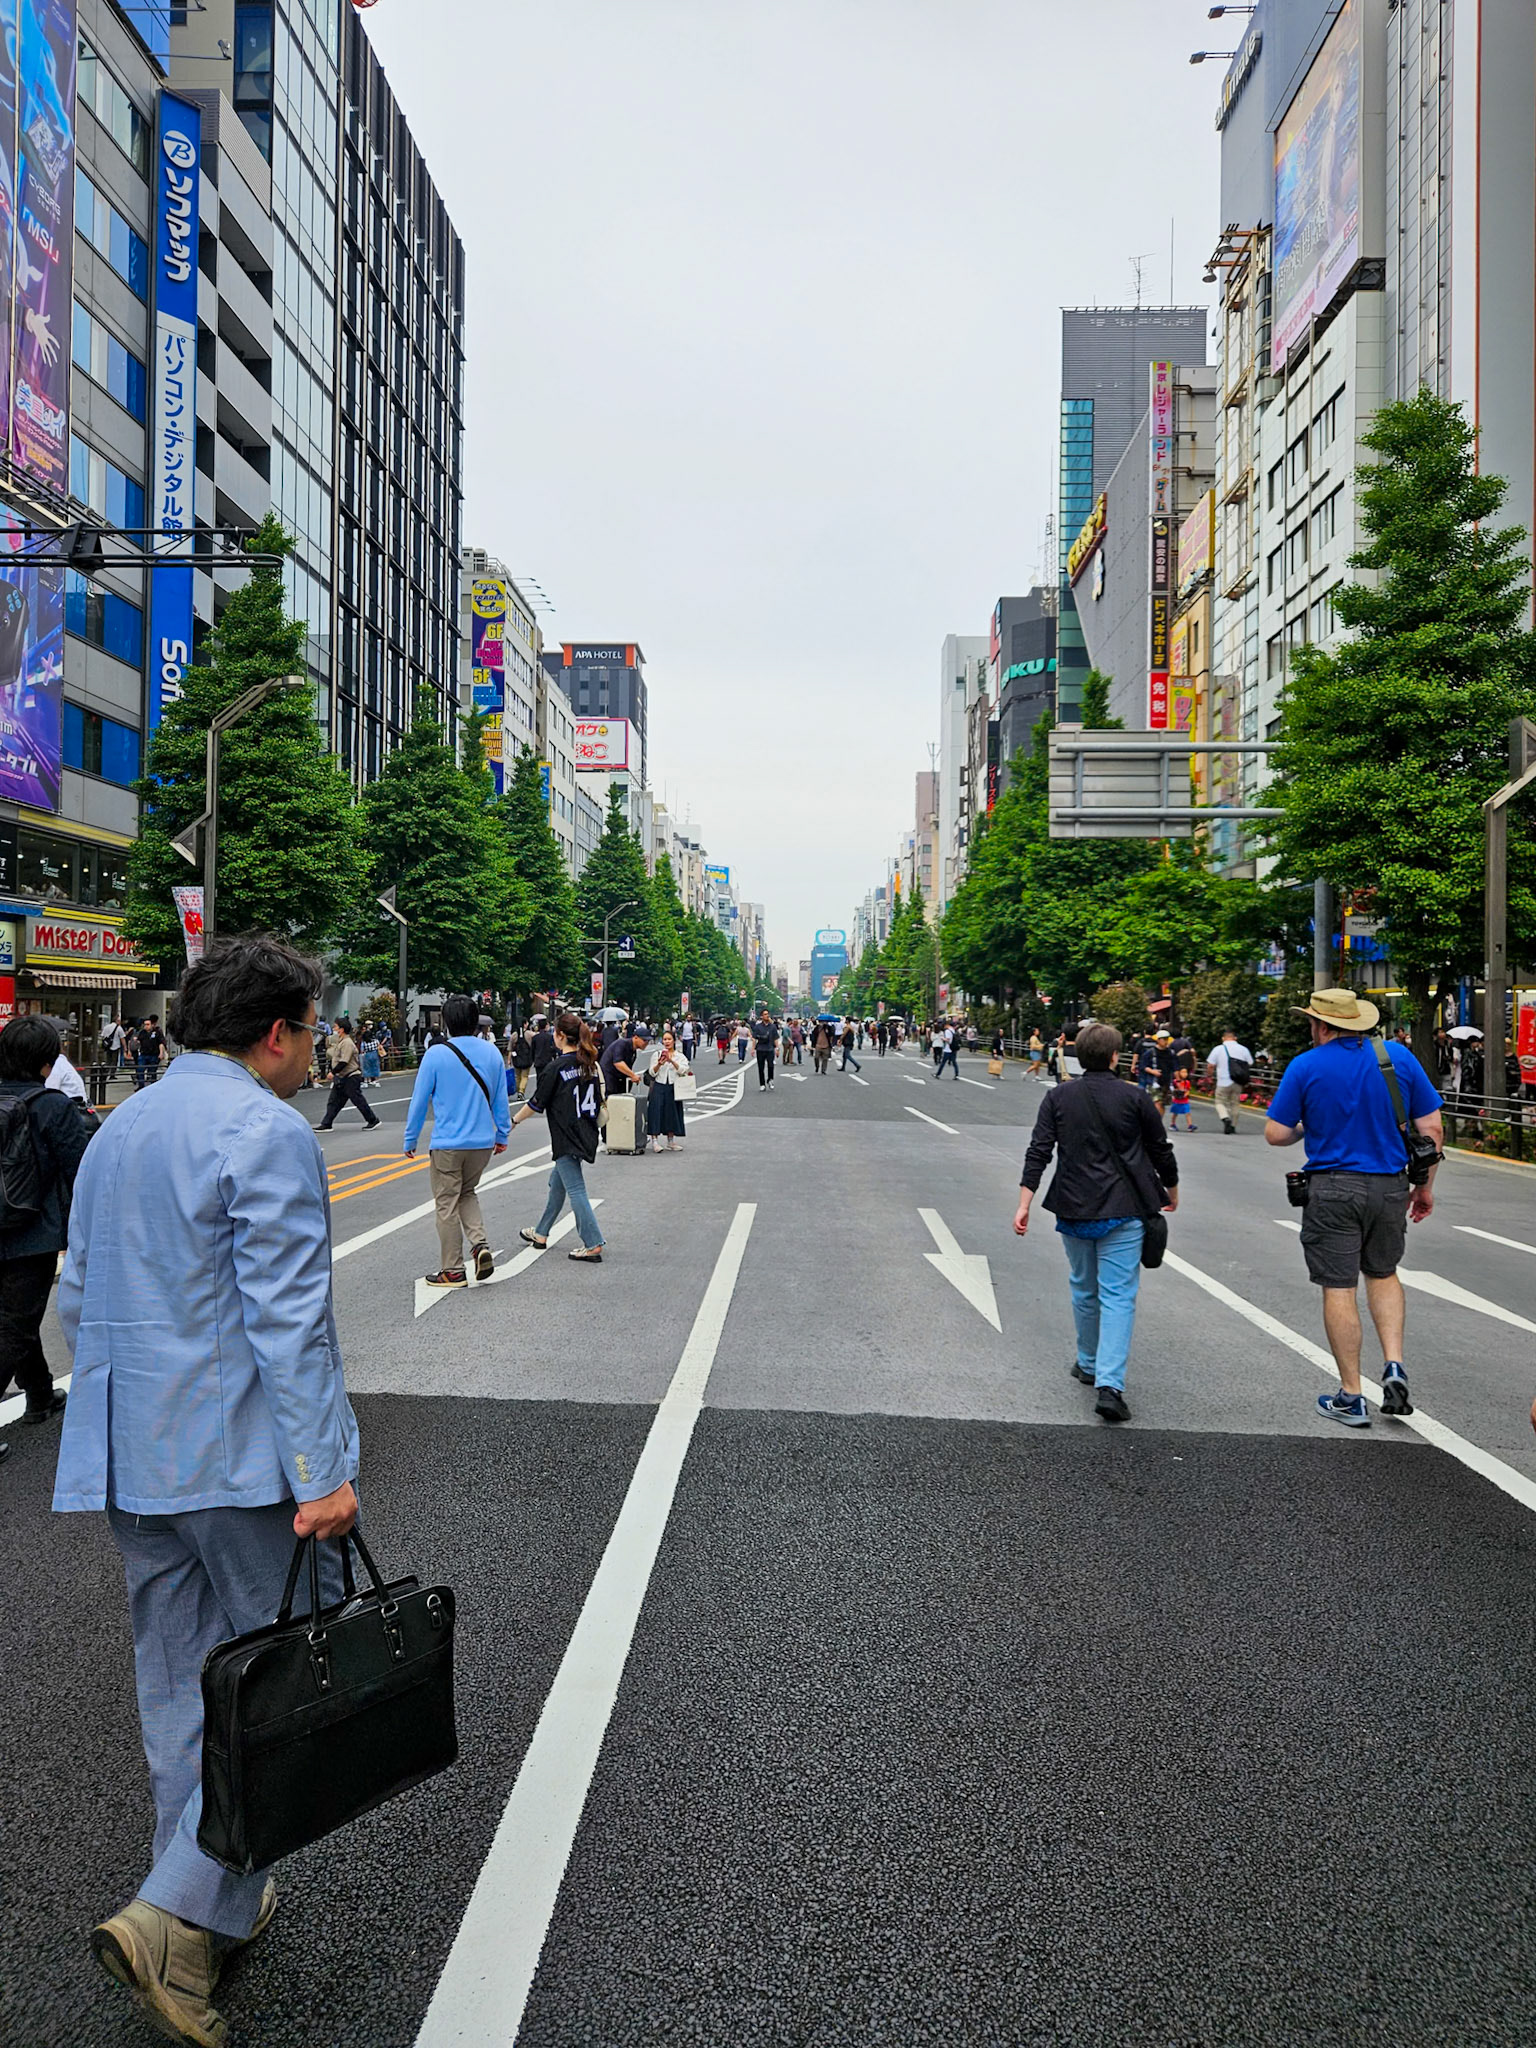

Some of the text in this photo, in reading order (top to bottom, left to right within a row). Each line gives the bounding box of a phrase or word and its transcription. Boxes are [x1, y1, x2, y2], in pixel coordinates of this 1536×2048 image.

[29, 173, 61, 216] CYBORG
[27, 215, 53, 255] MSI
[164, 166, 193, 281] ソフマップ
[162, 335, 186, 541] パソコン・デジタル館
[487, 624, 504, 639] 6F
[575, 651, 622, 659] APA HOTEL
[473, 668, 490, 684] 5F
[1152, 682, 1166, 713] 免税
[576, 743, 607, 759] ねこ
[35, 924, 98, 952] Mister
[0, 1004, 13, 1016] TAX
[573, 1084, 597, 1118] 14
